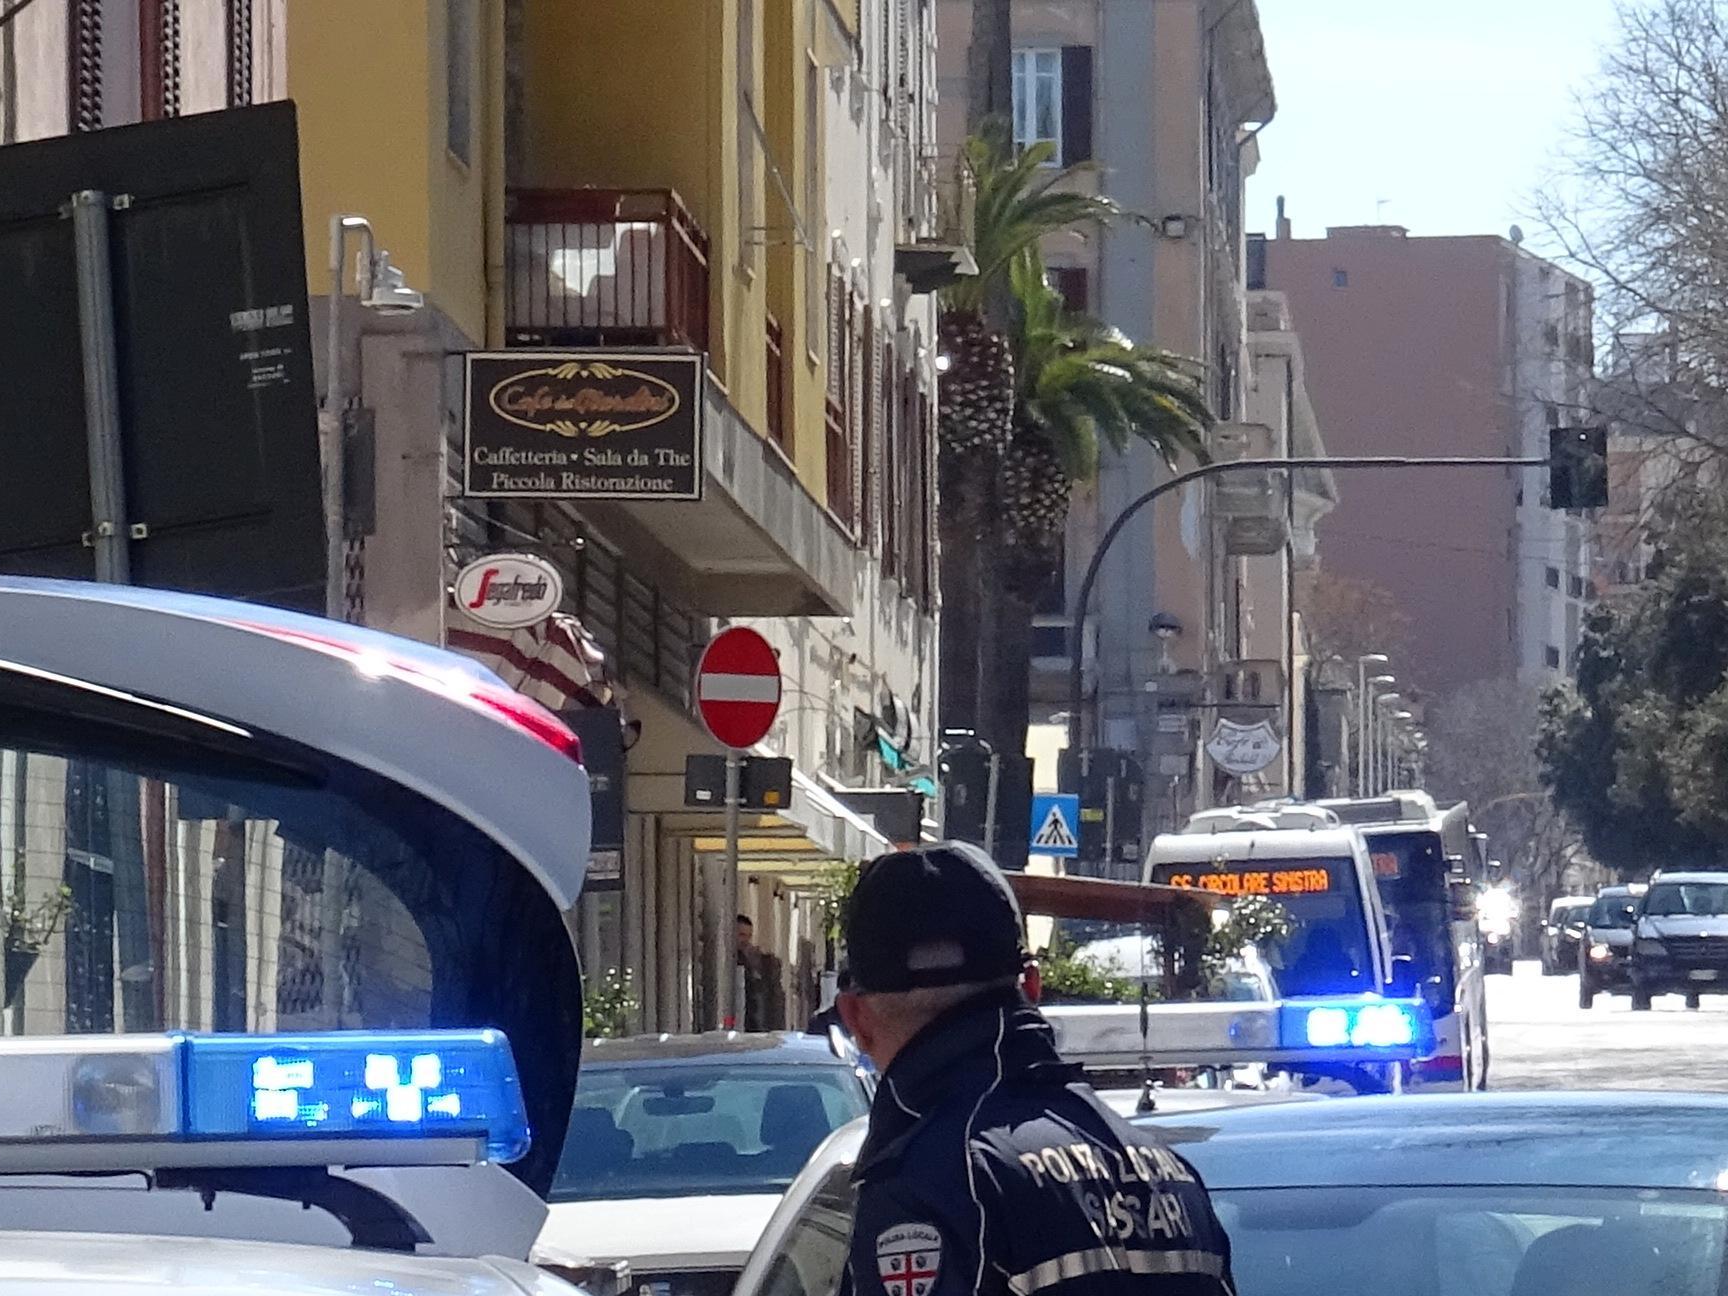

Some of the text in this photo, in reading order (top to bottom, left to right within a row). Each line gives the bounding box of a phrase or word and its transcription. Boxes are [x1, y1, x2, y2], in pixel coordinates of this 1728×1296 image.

[473, 446, 691, 467] Caffetteria Sala da The
[491, 472, 674, 492] Piccola Ristorazione
